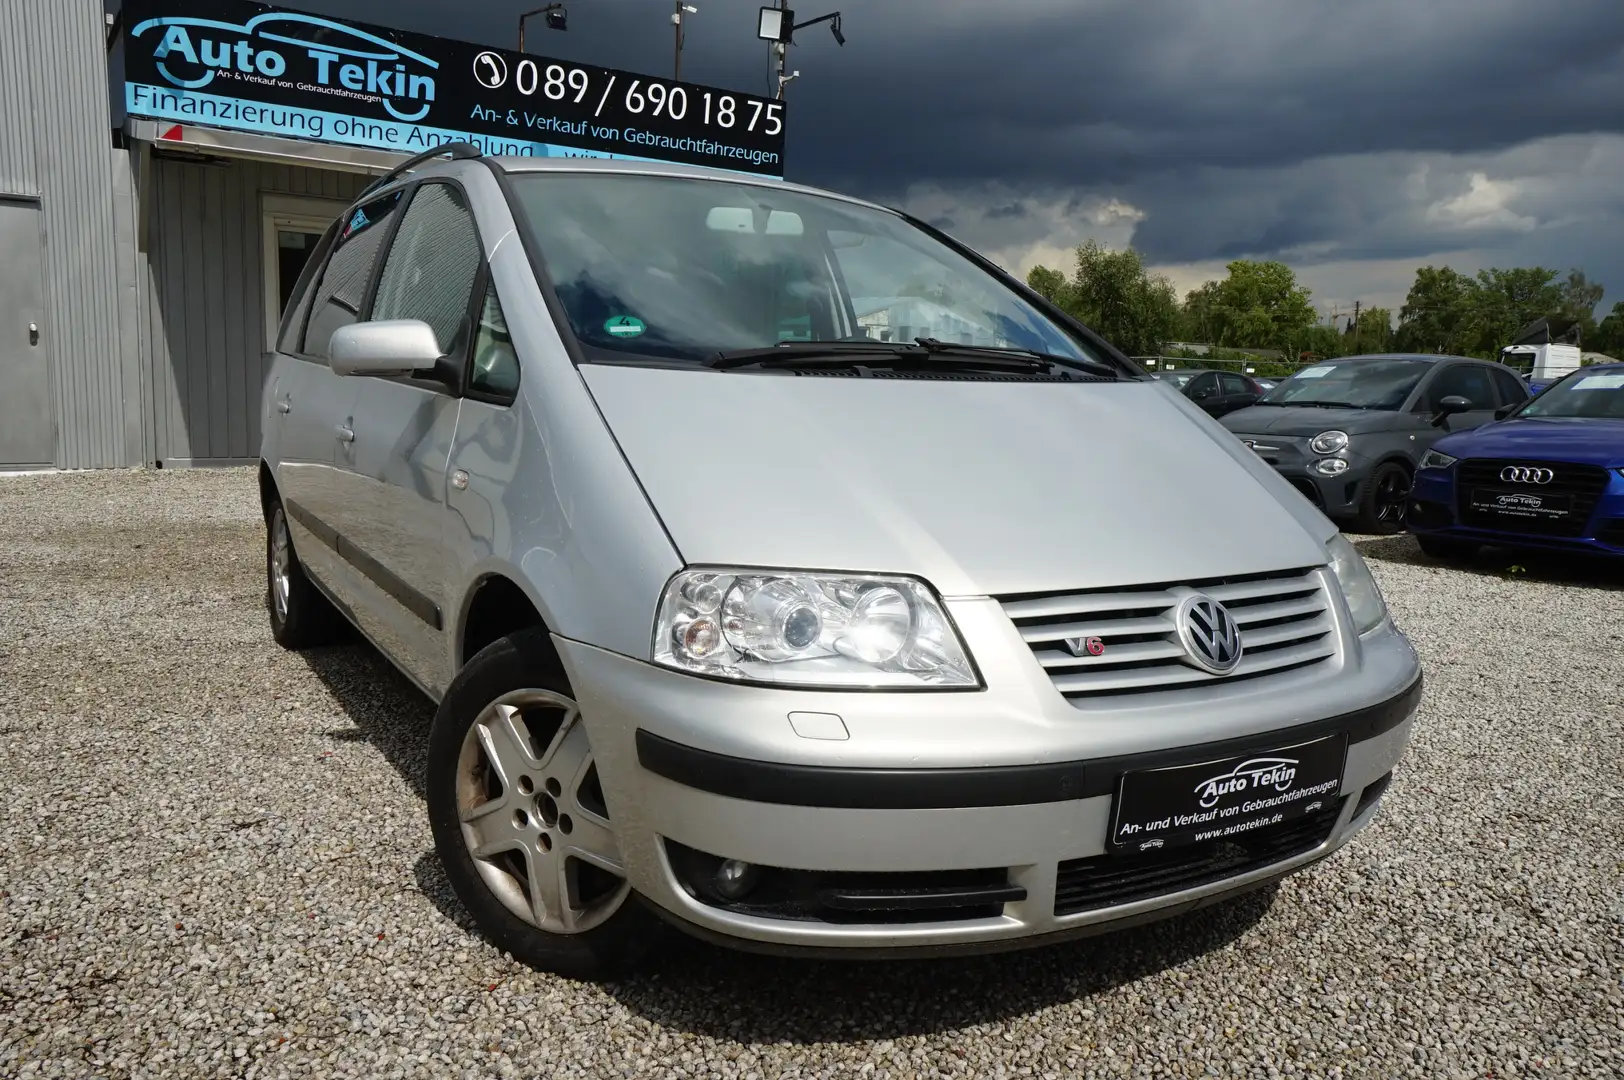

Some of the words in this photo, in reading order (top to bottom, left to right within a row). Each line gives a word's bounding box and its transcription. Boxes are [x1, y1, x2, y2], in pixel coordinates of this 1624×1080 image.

[153, 25, 286, 76] Auto
[308, 49, 436, 102] Tekin
[216, 69, 234, 80] An-
[234, 71, 242, 81] &
[243, 73, 277, 87] Verkauf
[277, 79, 294, 89] von
[296, 82, 381, 103] Gebrauchtfahrzeugen
[516, 59, 589, 104] 089
[594, 75, 616, 117] /
[625, 80, 688, 121] 690
[703, 92, 736, 128] 18
[747, 100, 783, 136] 75
[132, 84, 324, 137] Finanzierung
[334, 116, 399, 143] ohne
[470, 103, 502, 122] An-
[506, 109, 519, 127] &
[524, 112, 587, 137] Verkauf
[591, 125, 619, 141] von
[624, 128, 779, 166] Gebrauchtfahrzeugen
[619, 316, 631, 326] 4
[1520, 497, 1541, 505] Tekin
[1064, 636, 1105, 657] V6
[1202, 779, 1247, 798] Auto
[1252, 766, 1297, 788] Tekin
[1119, 822, 1143, 836] An-
[1145, 816, 1170, 832] und
[1174, 808, 1218, 827] Verkauf
[1219, 806, 1239, 818] von
[1242, 779, 1338, 813] Gebrauchtfahrzeugen
[1195, 812, 1283, 841] www.autotekin.de
